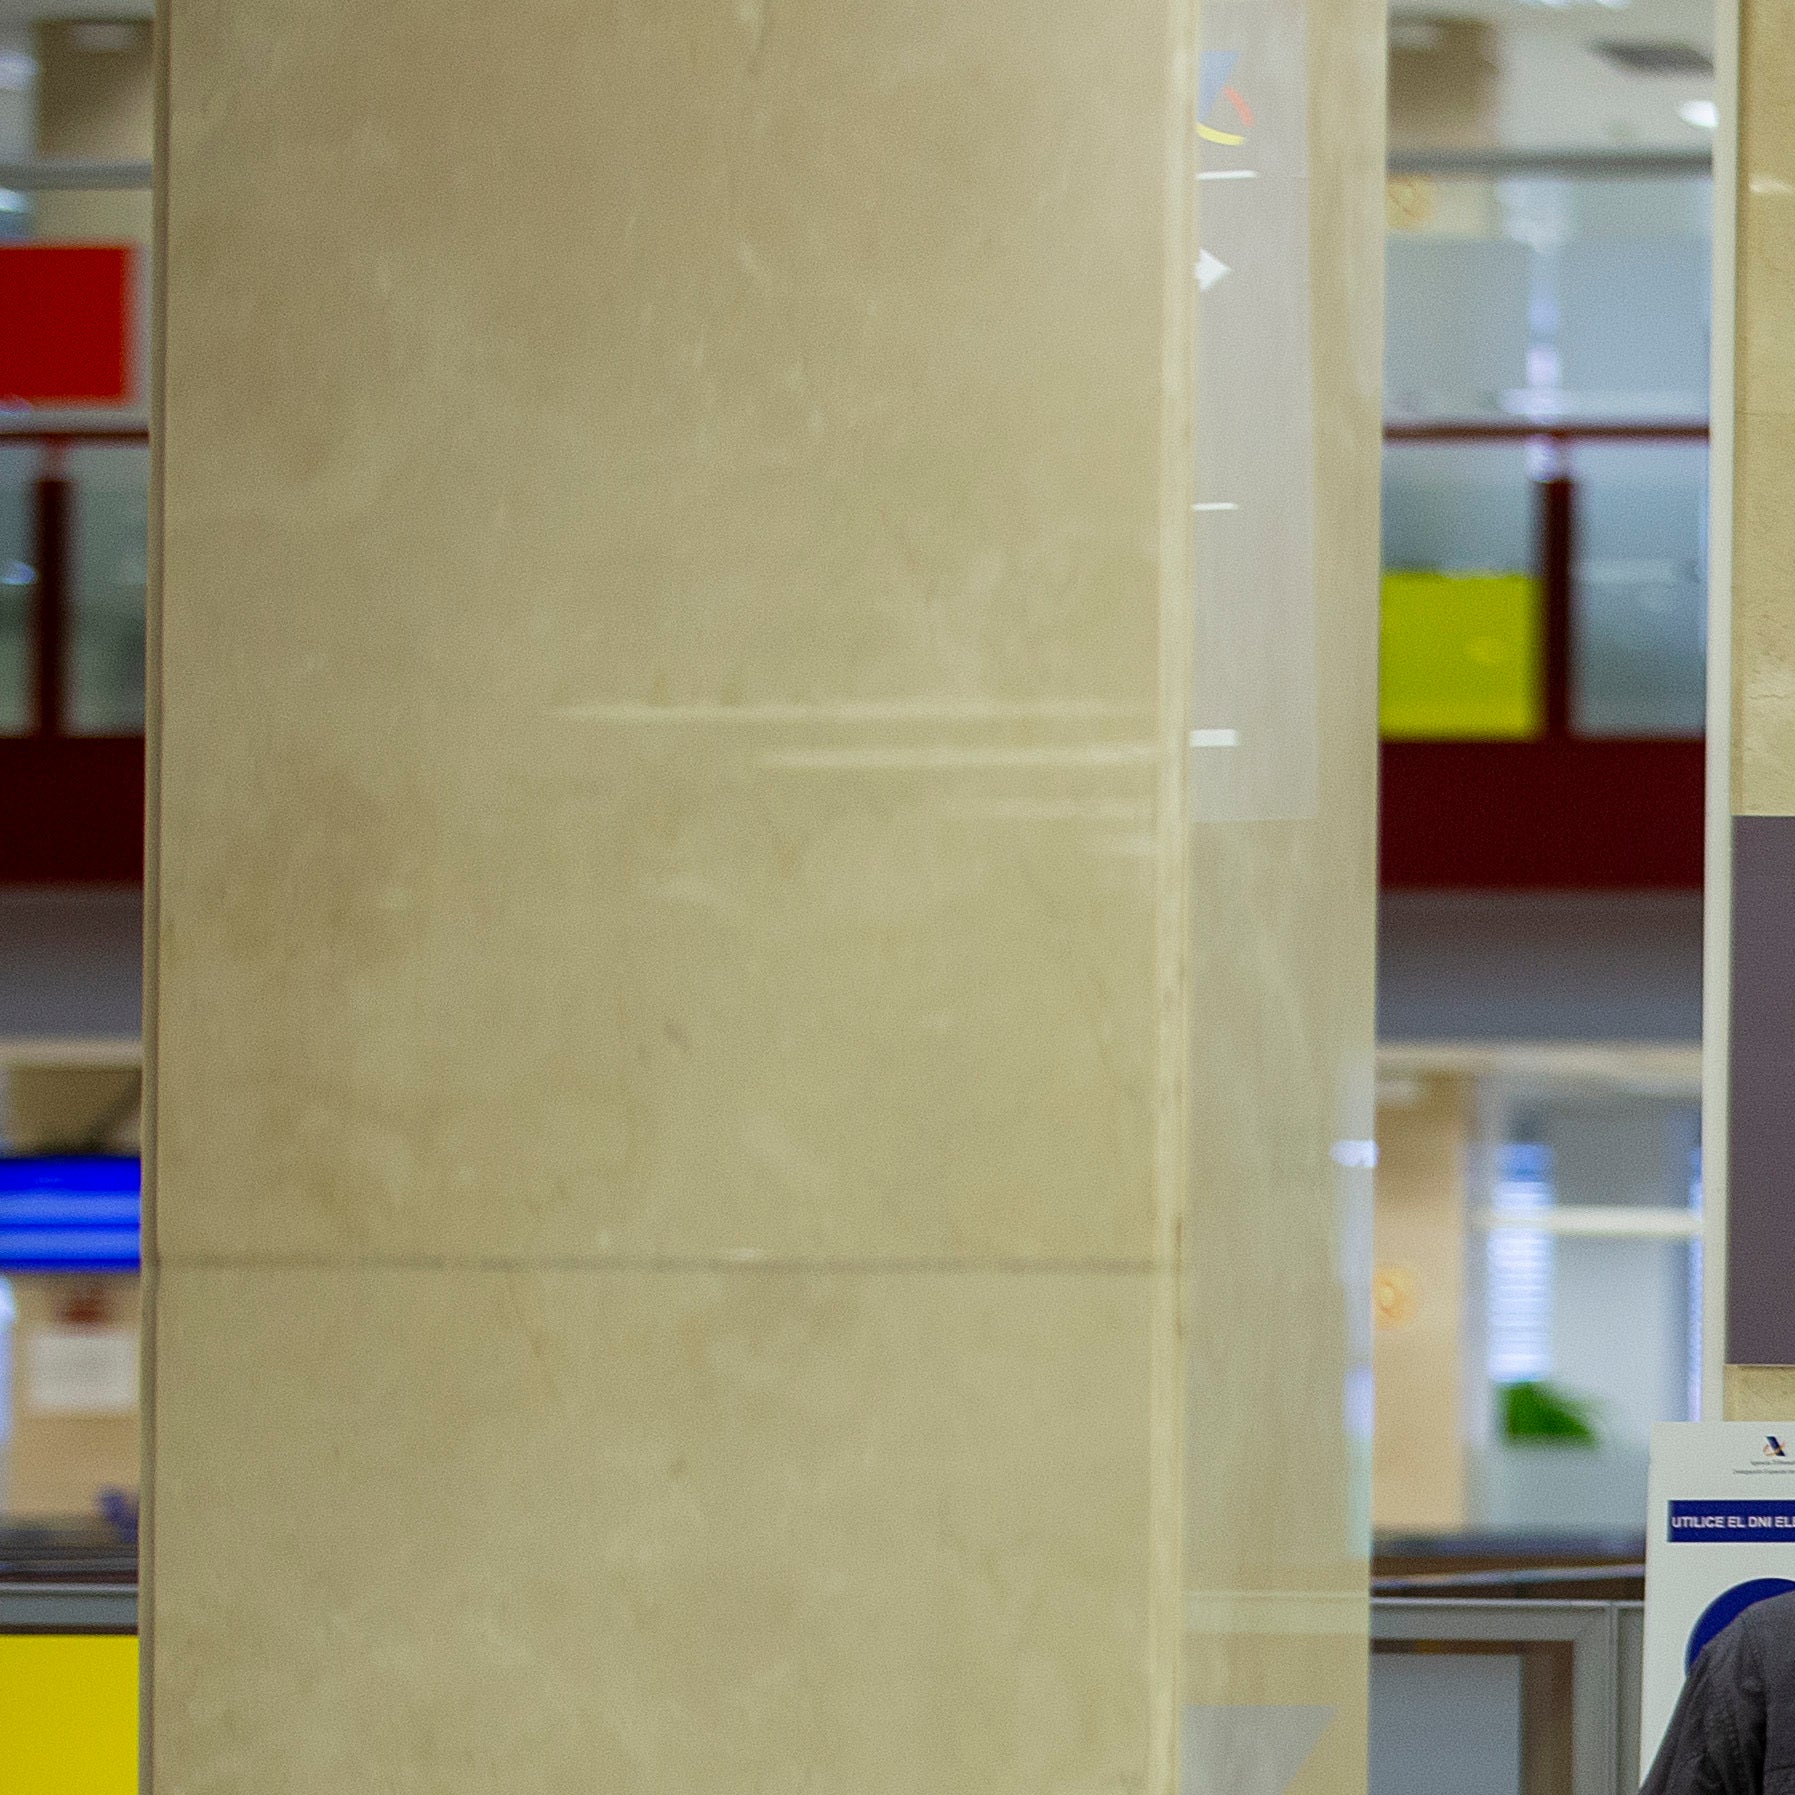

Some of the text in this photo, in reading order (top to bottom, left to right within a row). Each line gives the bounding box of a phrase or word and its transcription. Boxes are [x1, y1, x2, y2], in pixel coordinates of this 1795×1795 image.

[1671, 1515, 1724, 1529] UTILICE
[1727, 1515, 1746, 1529] EL
[1748, 1515, 1773, 1529] DNI
